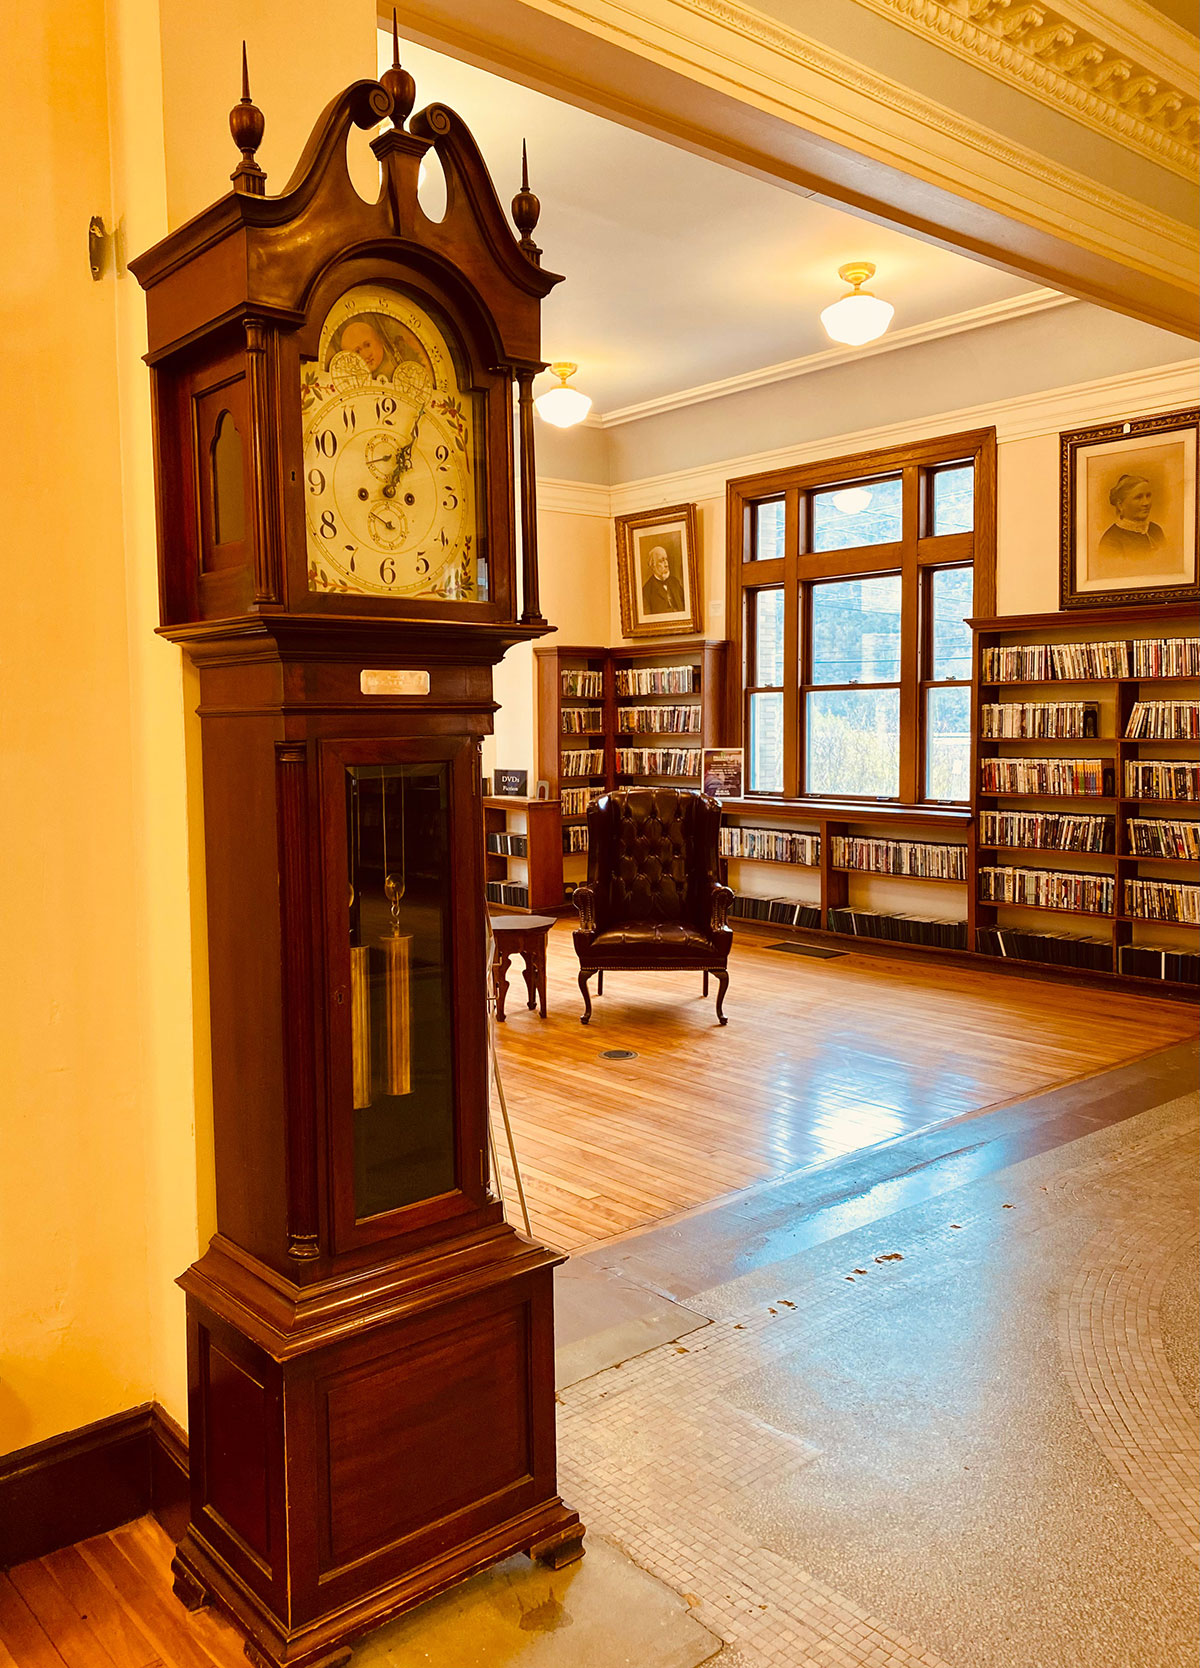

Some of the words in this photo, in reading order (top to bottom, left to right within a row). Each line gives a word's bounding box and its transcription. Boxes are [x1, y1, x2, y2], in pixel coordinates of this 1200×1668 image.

[342, 404, 356, 433] 11
[375, 397, 397, 425] 12
[314, 429, 337, 458] 10
[435, 445, 451, 472] 2
[308, 468, 326, 496] 9
[442, 485, 458, 510] 3
[319, 510, 337, 539] 8
[433, 527, 449, 552] 4
[342, 544, 358, 572] 7
[379, 557, 396, 585] 6
[415, 551, 430, 575] 5
[501, 775, 520, 783] DVDs
